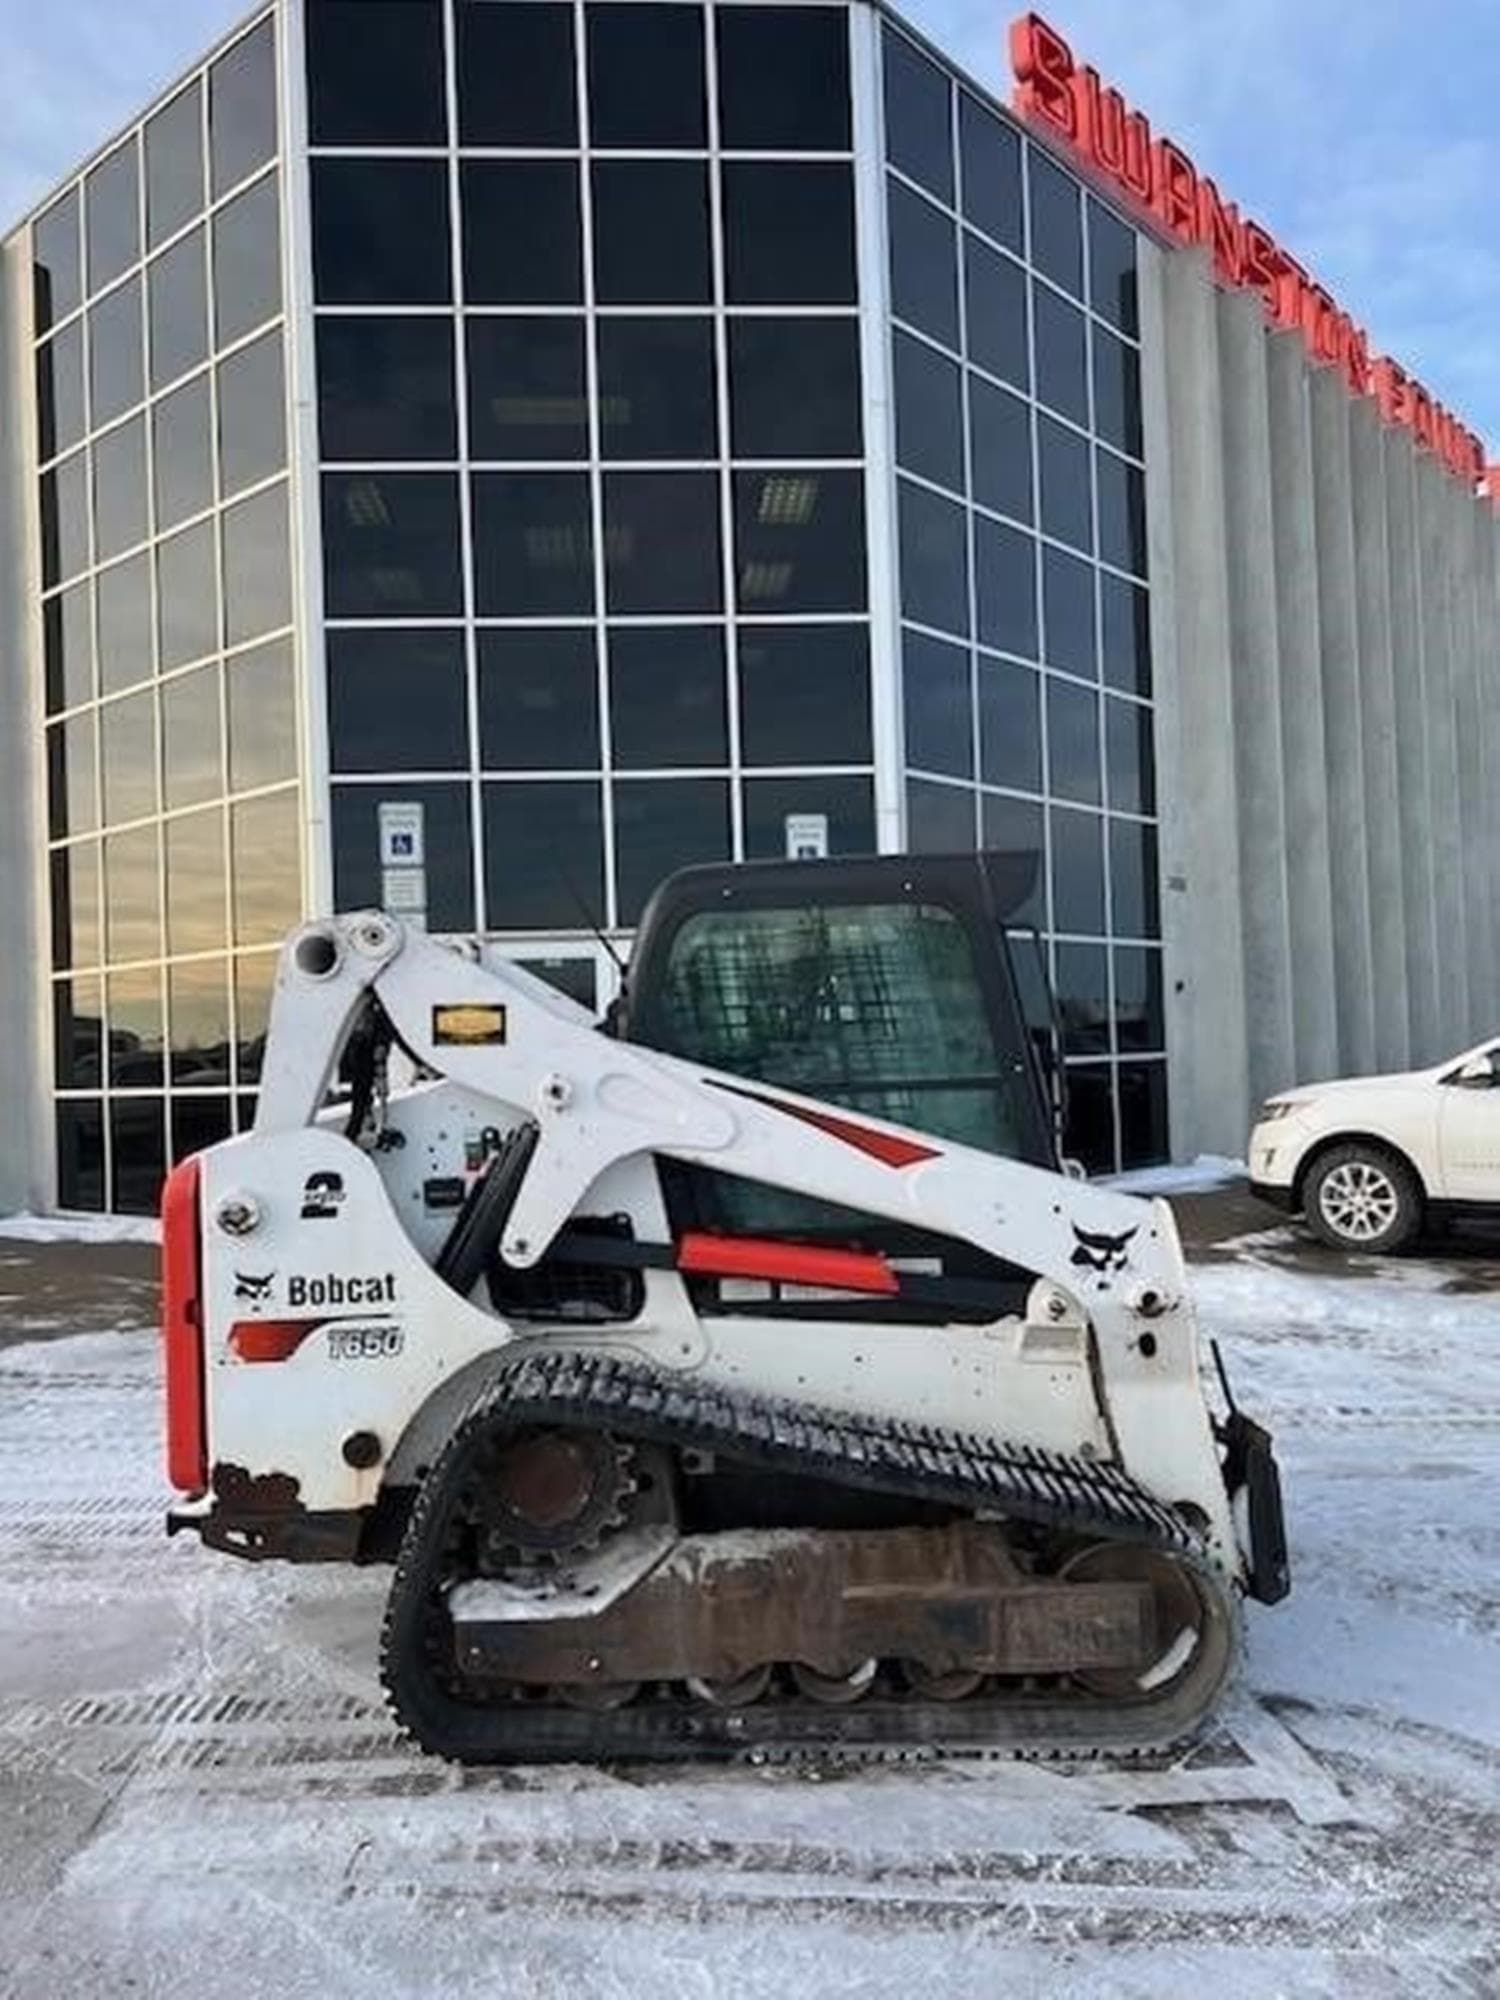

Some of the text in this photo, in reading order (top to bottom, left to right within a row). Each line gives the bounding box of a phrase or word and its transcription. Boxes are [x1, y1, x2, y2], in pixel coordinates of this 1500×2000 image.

[1010, 12, 1368, 398] SWANSTON
[288, 1272, 396, 1306] Bobcat
[327, 1326, 405, 1359] T650
